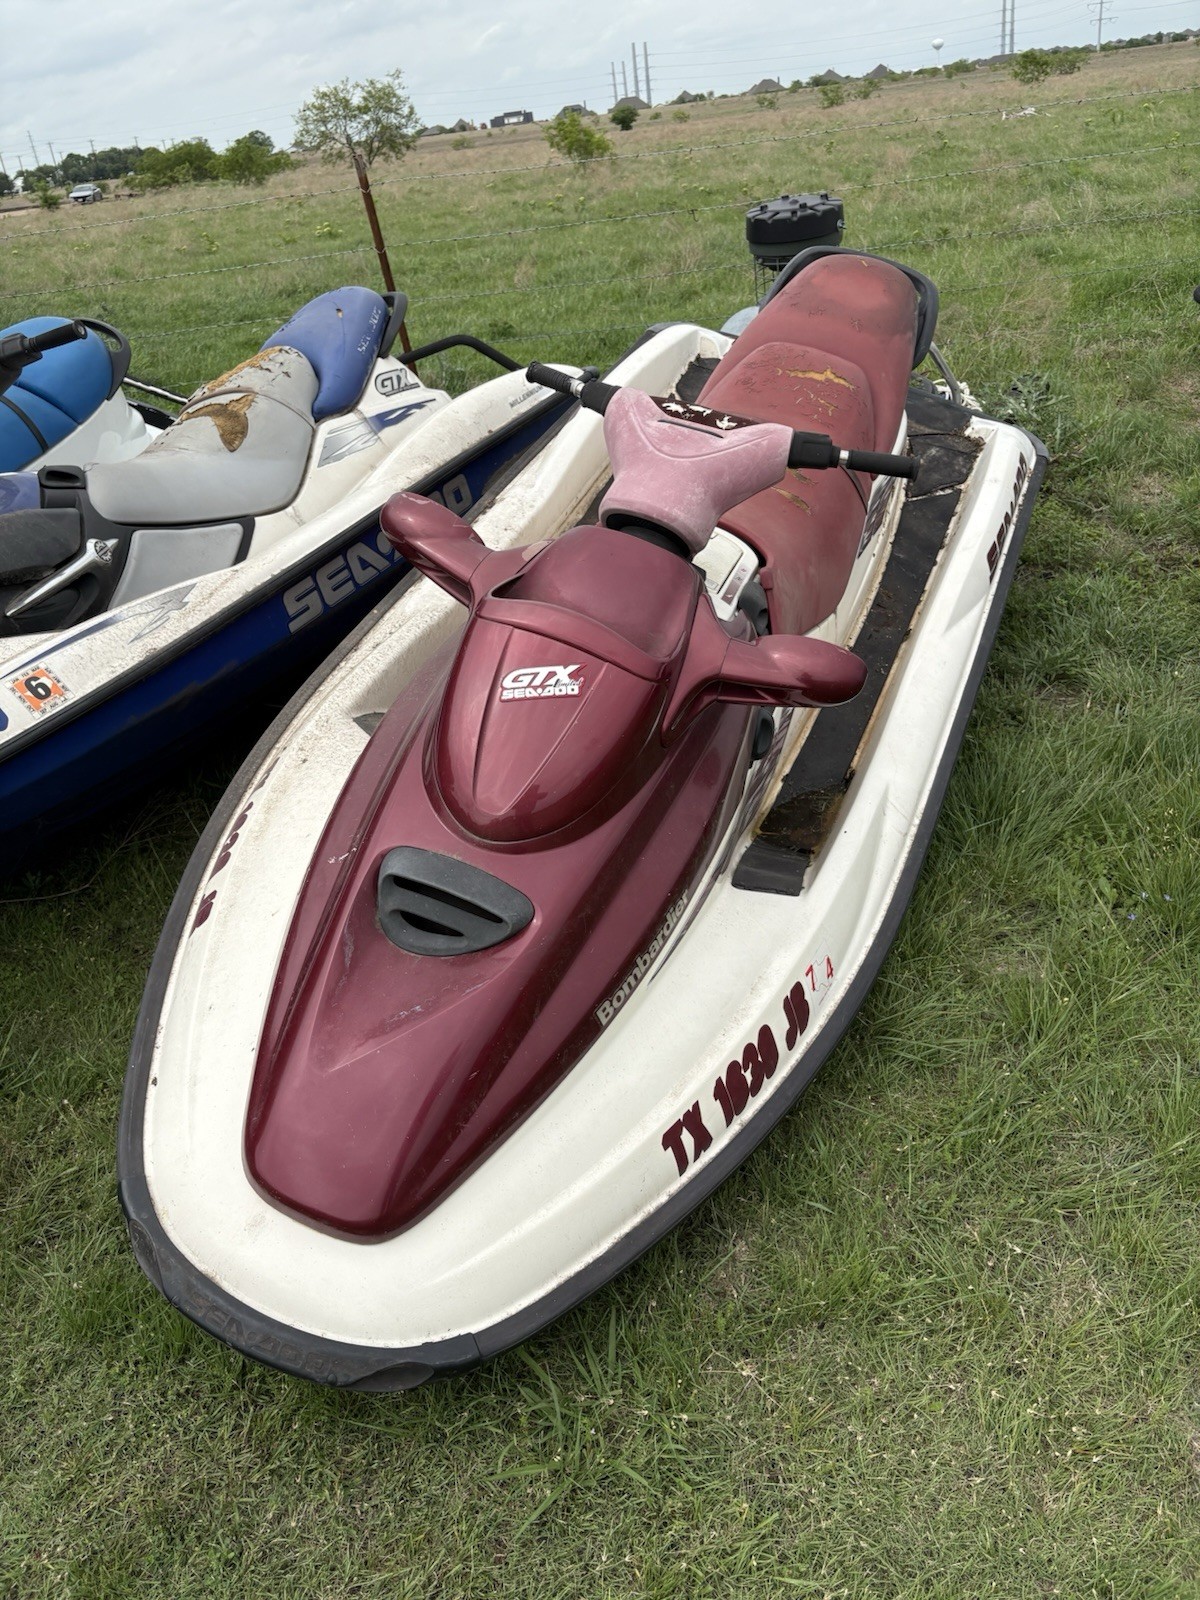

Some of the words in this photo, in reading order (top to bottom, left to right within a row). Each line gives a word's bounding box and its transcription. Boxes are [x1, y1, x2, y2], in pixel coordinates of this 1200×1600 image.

[375, 368, 414, 396] GTX
[24, 676, 52, 700] 6
[502, 664, 581, 688] GTX
[594, 889, 690, 1027] Bombardier
[661, 1100, 713, 1177] TX
[783, 981, 810, 1051] JB
